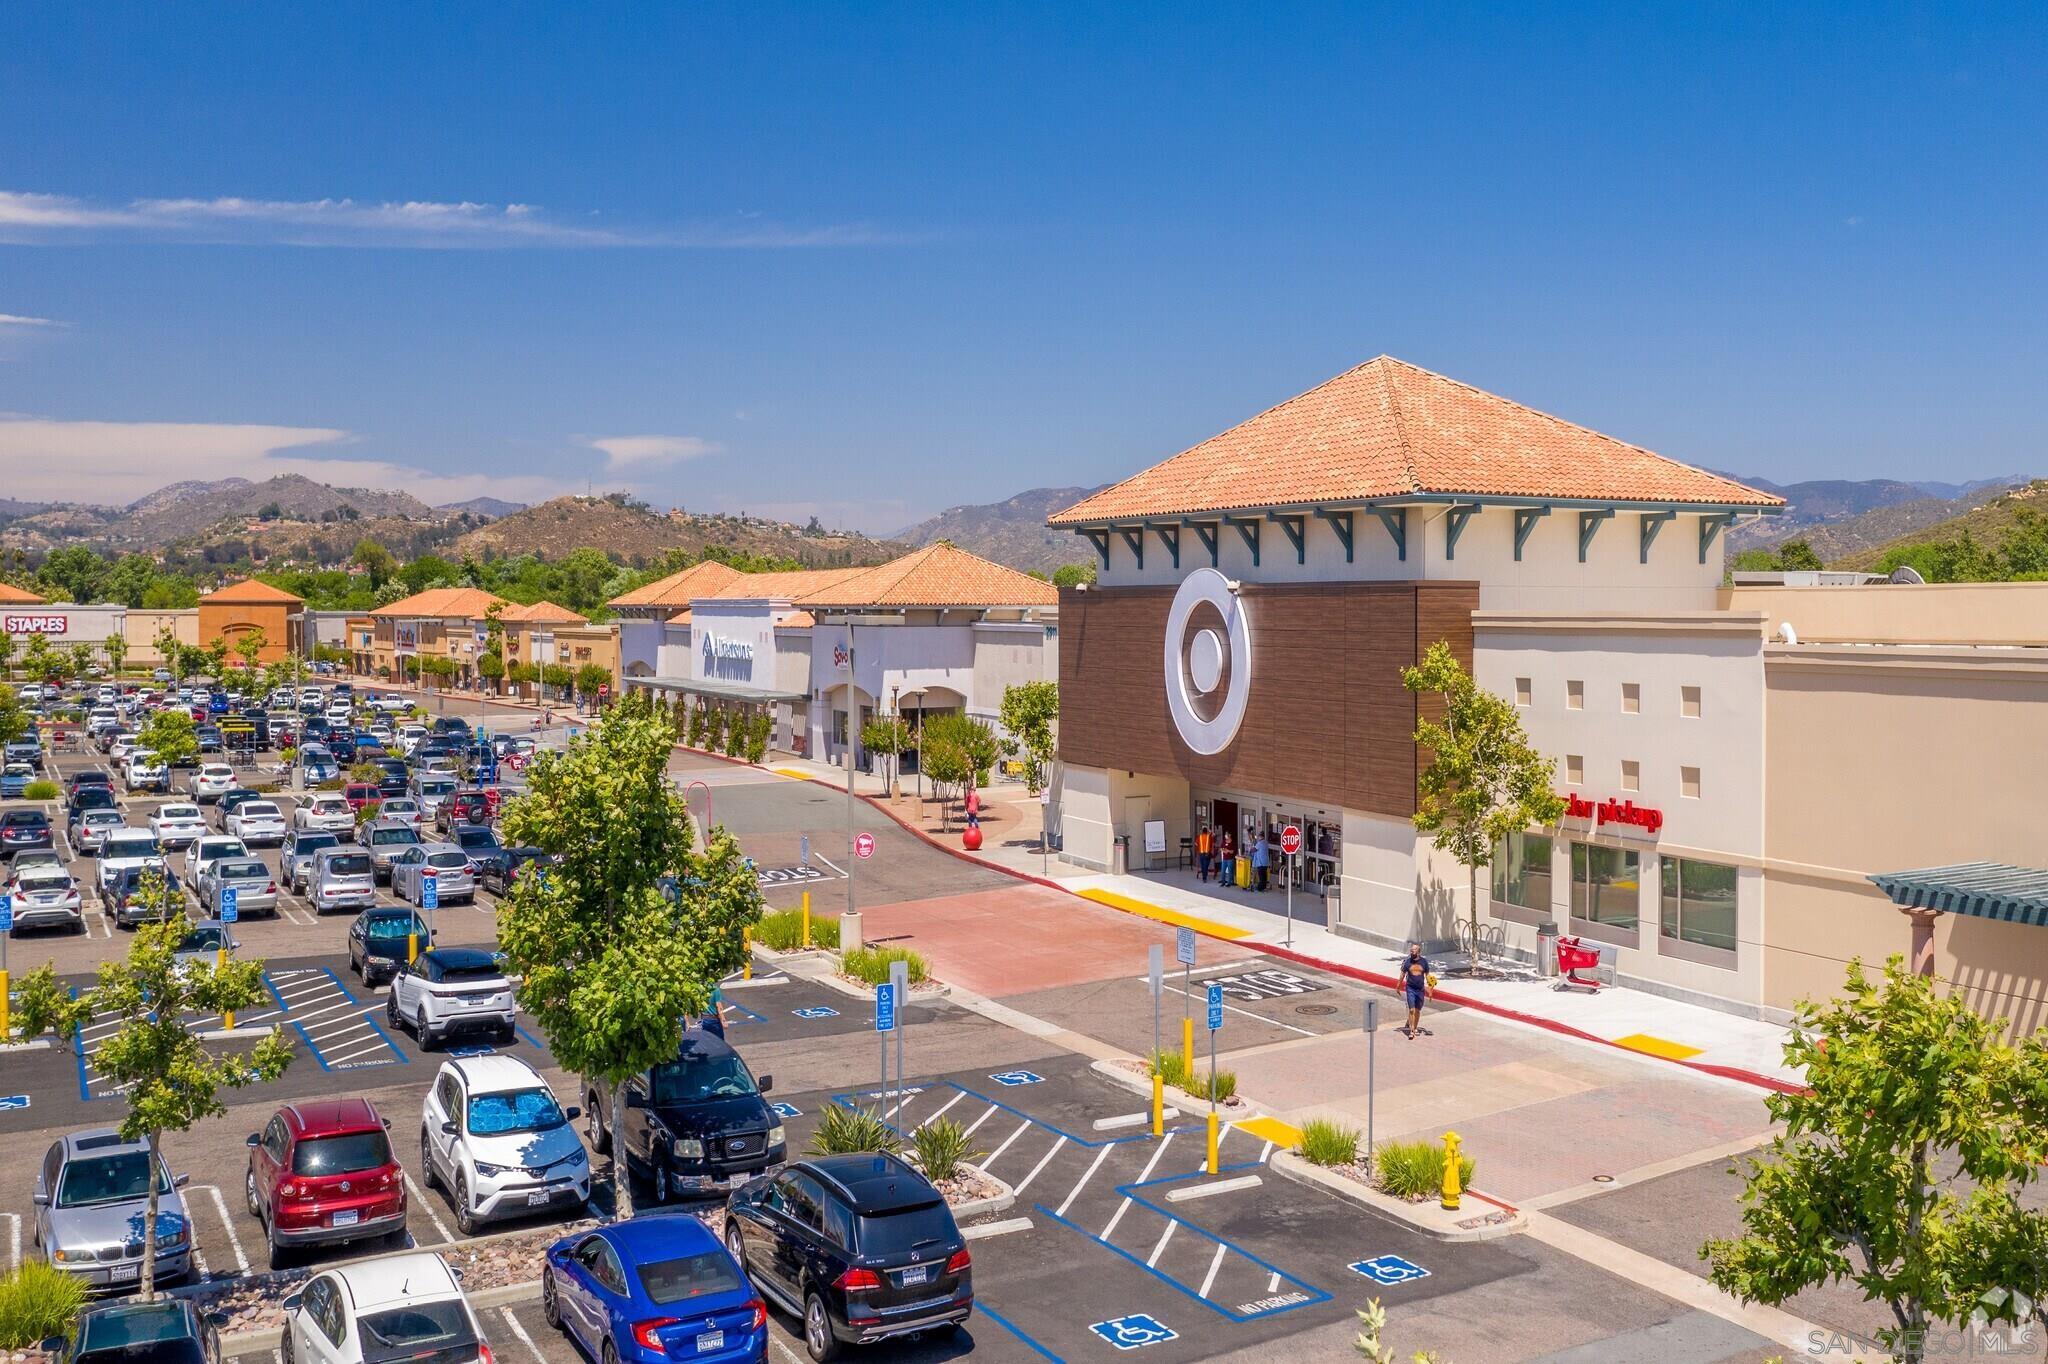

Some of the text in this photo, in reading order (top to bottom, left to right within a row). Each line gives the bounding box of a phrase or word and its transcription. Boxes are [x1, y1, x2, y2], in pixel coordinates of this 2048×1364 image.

[7, 617, 65, 632] STAPLES
[1562, 793, 1663, 833] der pickup
[1282, 834, 1300, 846] STOP
[1203, 969, 1317, 1000] STOP
[1236, 1292, 1309, 1314] NO PARKING
